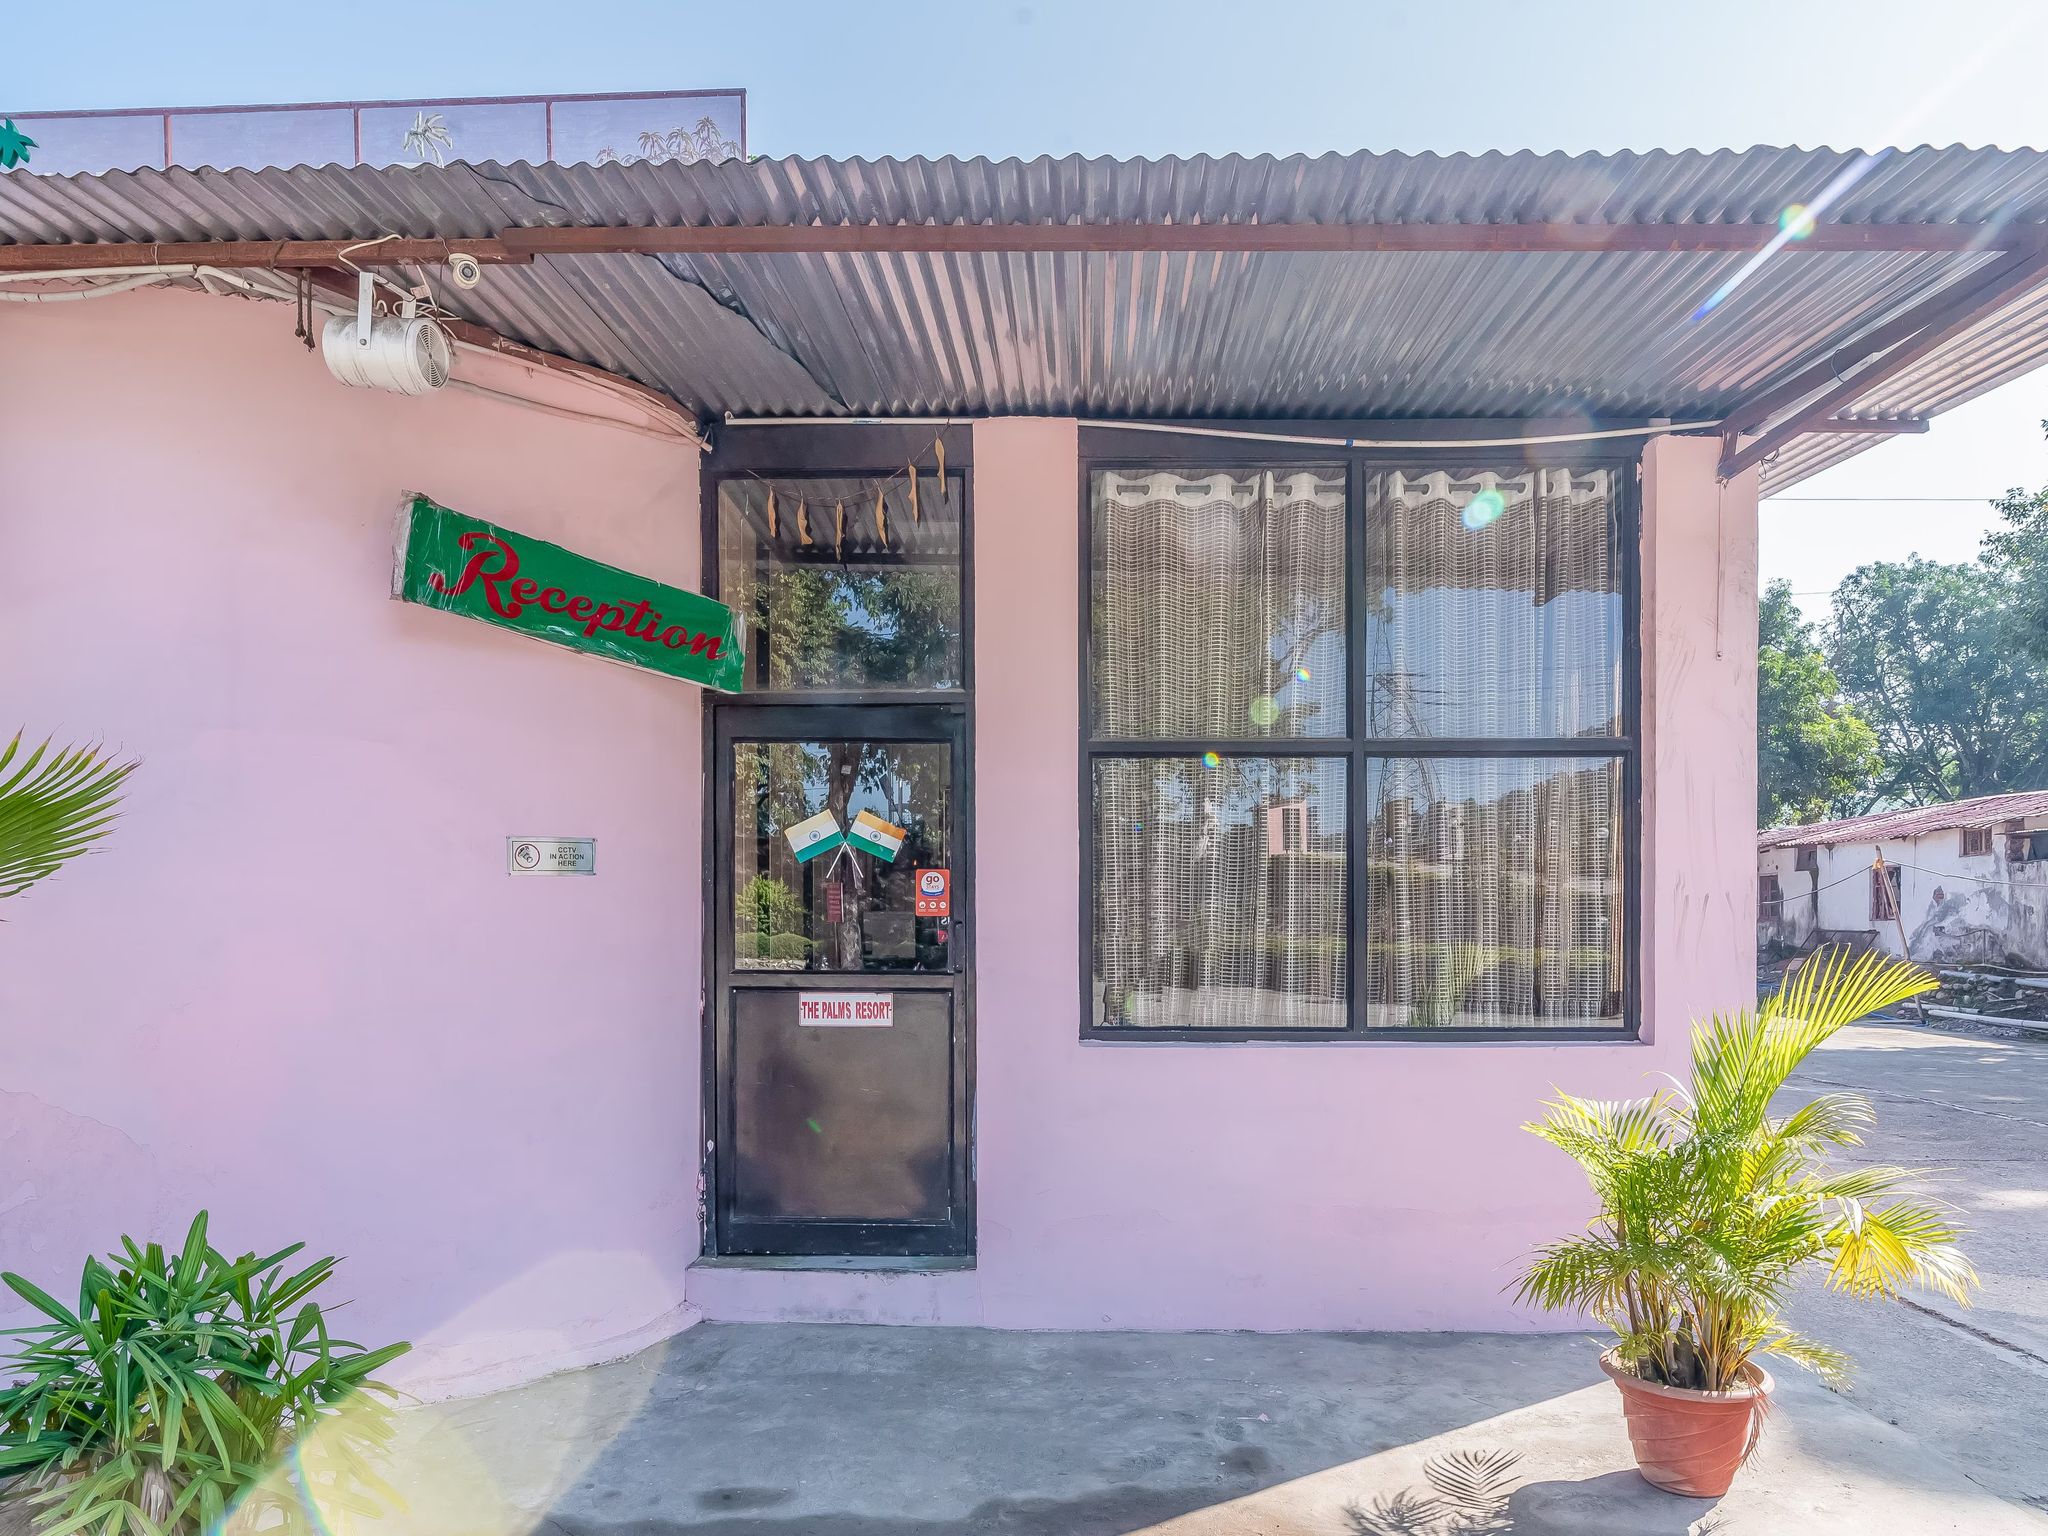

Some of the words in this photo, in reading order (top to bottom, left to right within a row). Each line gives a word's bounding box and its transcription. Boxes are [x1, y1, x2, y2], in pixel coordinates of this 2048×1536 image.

[429, 532, 728, 660] Reception
[926, 875, 940, 885] go
[802, 1001, 820, 1019] THE
[821, 1001, 852, 1019] PALMS
[855, 1001, 890, 1019] RESORT
